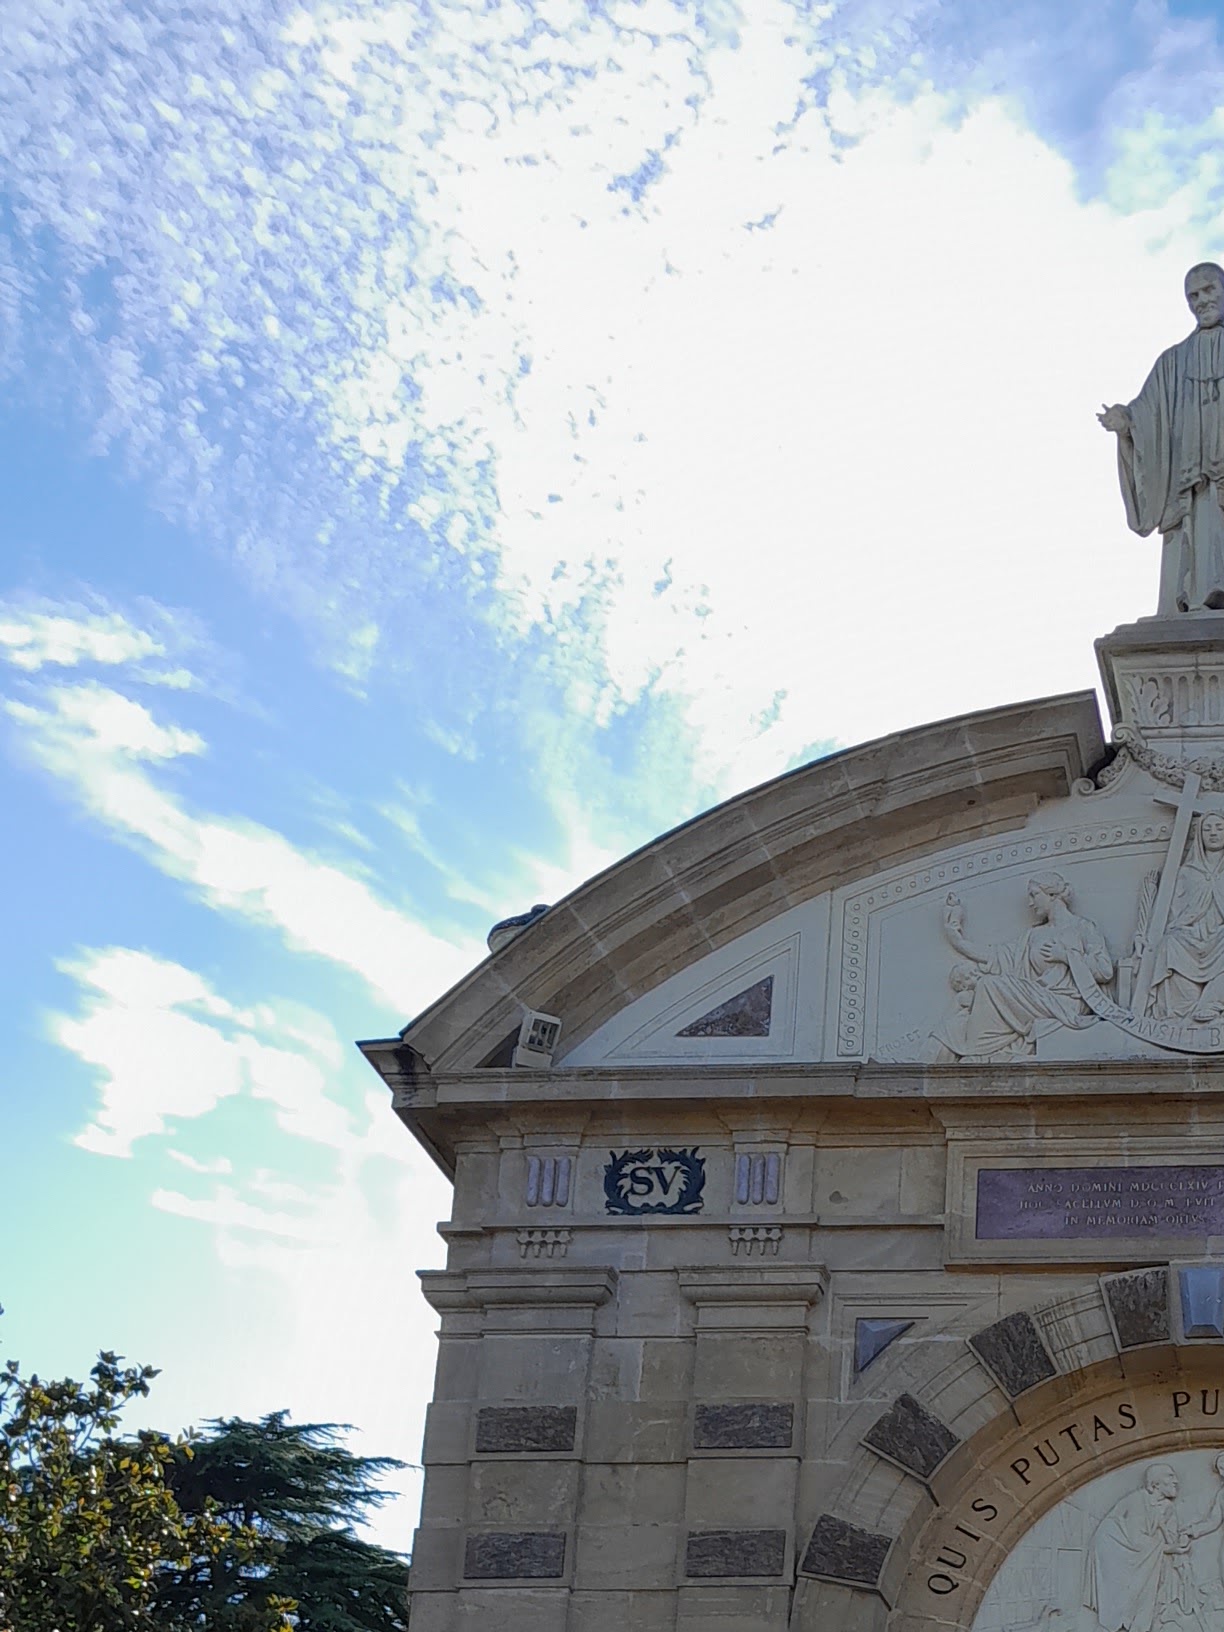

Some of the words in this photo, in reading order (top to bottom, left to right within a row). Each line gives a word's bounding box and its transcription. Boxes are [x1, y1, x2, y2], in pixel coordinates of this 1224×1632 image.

[629, 1165, 682, 1196] SV
[1027, 1181, 1063, 1193] ANNO
[1071, 1181, 1122, 1193] DOMINI
[1064, 1215, 1079, 1226] IN
[1086, 1214, 1159, 1226] MEMORIAM
[927, 1497, 998, 1595] QUIS
[1010, 1403, 1138, 1486] PUTAS
